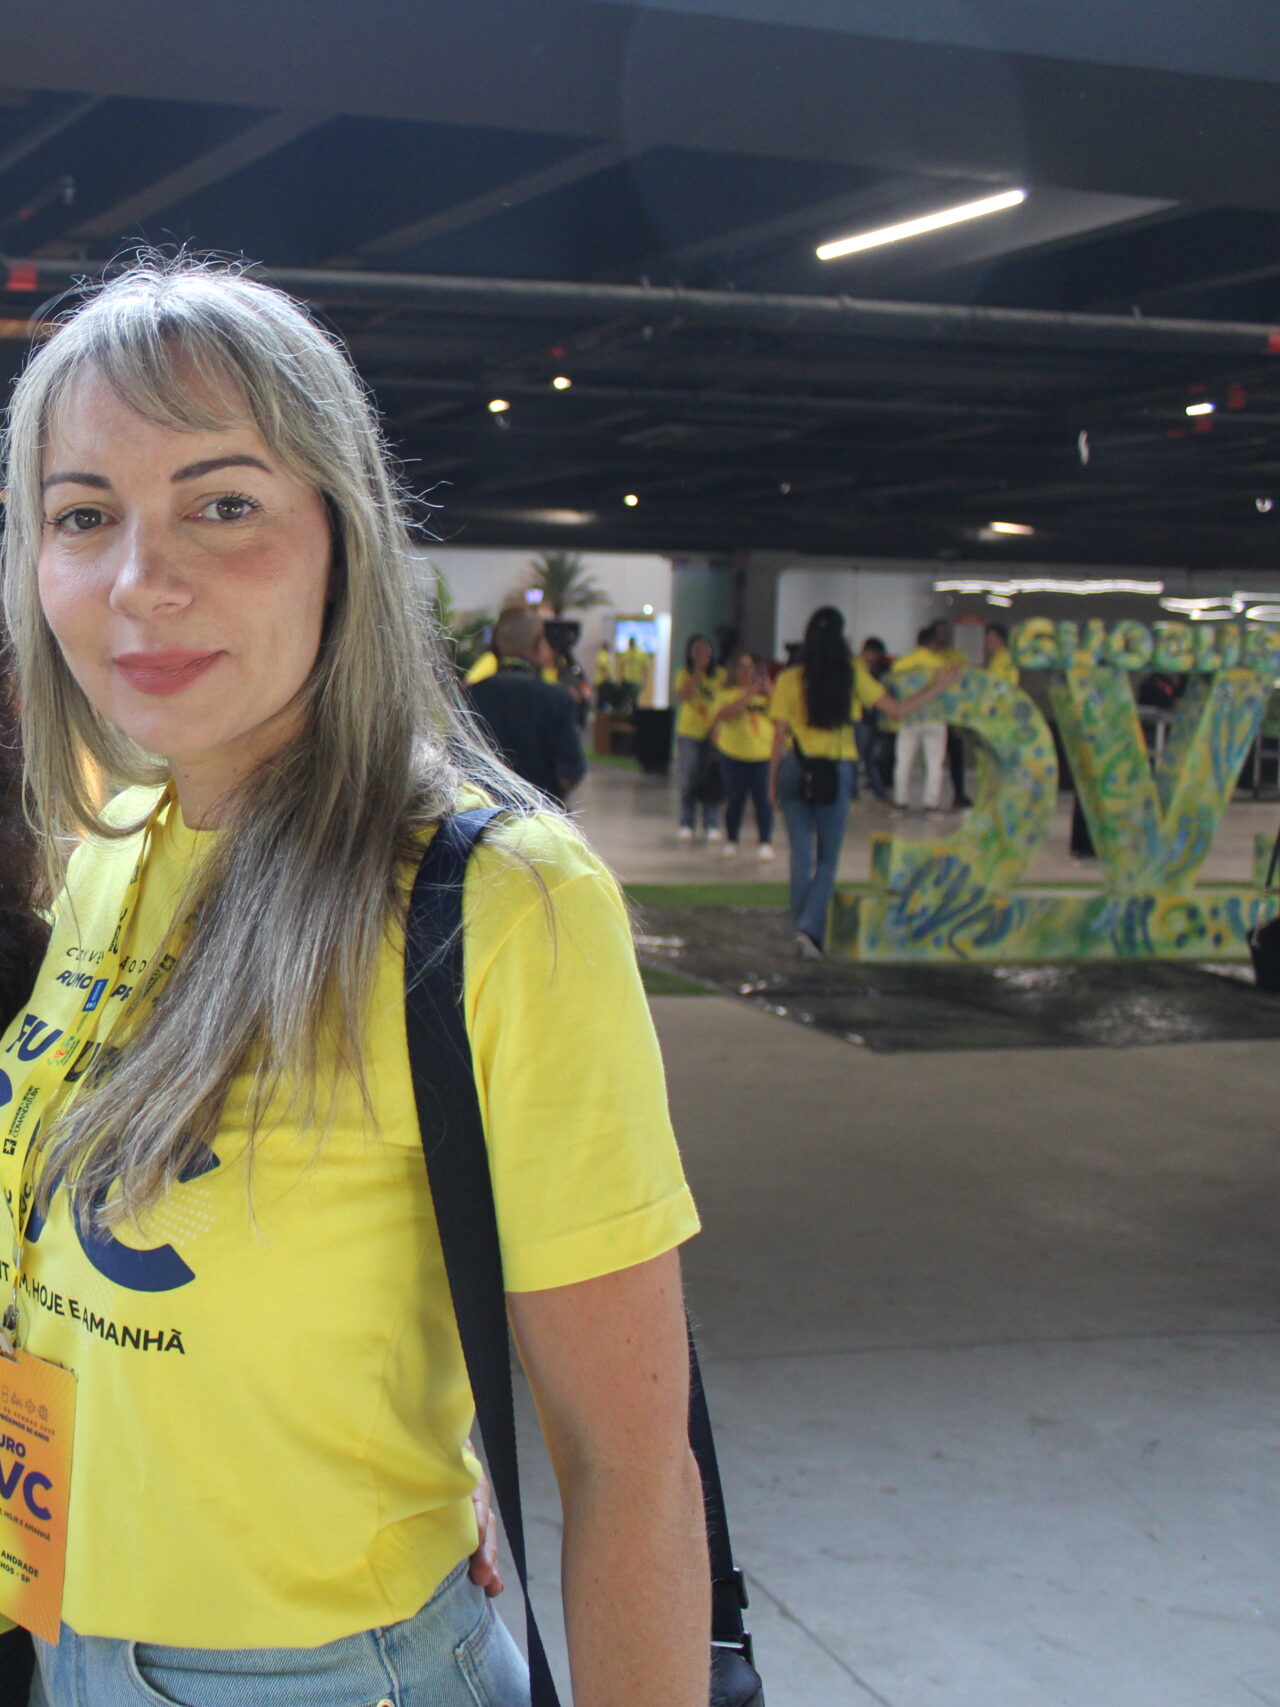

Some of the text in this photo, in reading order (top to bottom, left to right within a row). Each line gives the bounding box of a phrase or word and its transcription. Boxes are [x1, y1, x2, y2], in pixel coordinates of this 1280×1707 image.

[56, 970, 94, 990] RUMO
[32, 1279, 66, 1316] HOJE
[68, 1299, 81, 1320] E
[82, 1307, 185, 1355] AMANHÃ
[4, 1509, 19, 1523] HOJE
[24, 1521, 52, 1541] AMANHÃ
[1, 1550, 40, 1578] ANDRADE
[21, 1573, 31, 1583] SP
